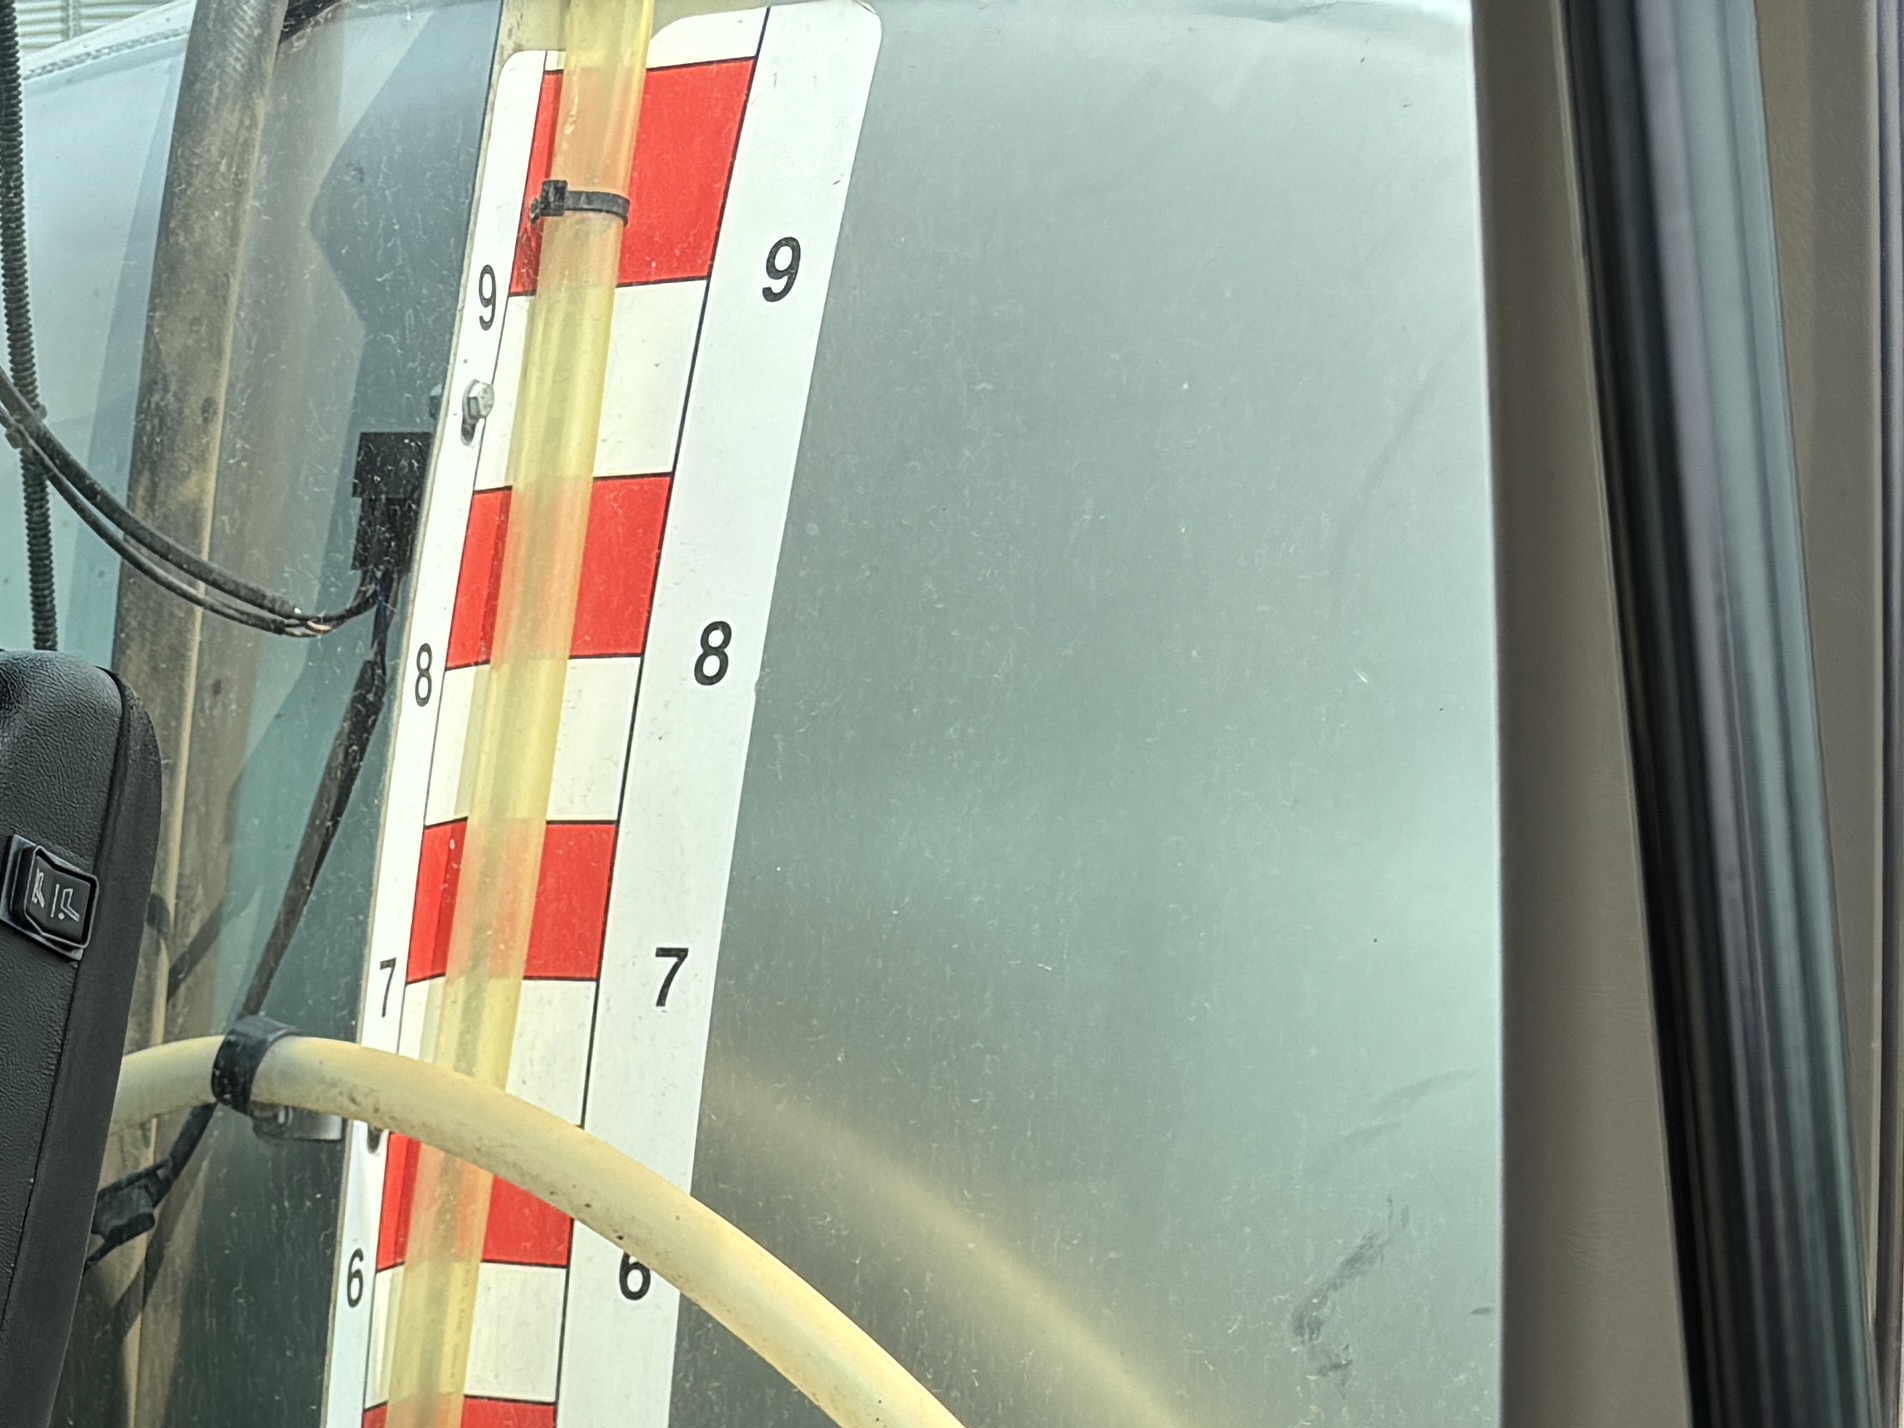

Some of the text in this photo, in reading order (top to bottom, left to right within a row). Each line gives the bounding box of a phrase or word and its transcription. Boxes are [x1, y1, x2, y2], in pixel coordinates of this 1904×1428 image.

[479, 265, 497, 331] 9
[763, 237, 802, 303] 9
[415, 644, 433, 707] 8
[694, 621, 733, 686] 8
[379, 960, 395, 1018] 7
[656, 946, 690, 1007] 7
[346, 1248, 364, 1309] 6
[618, 1253, 652, 1300] 6
